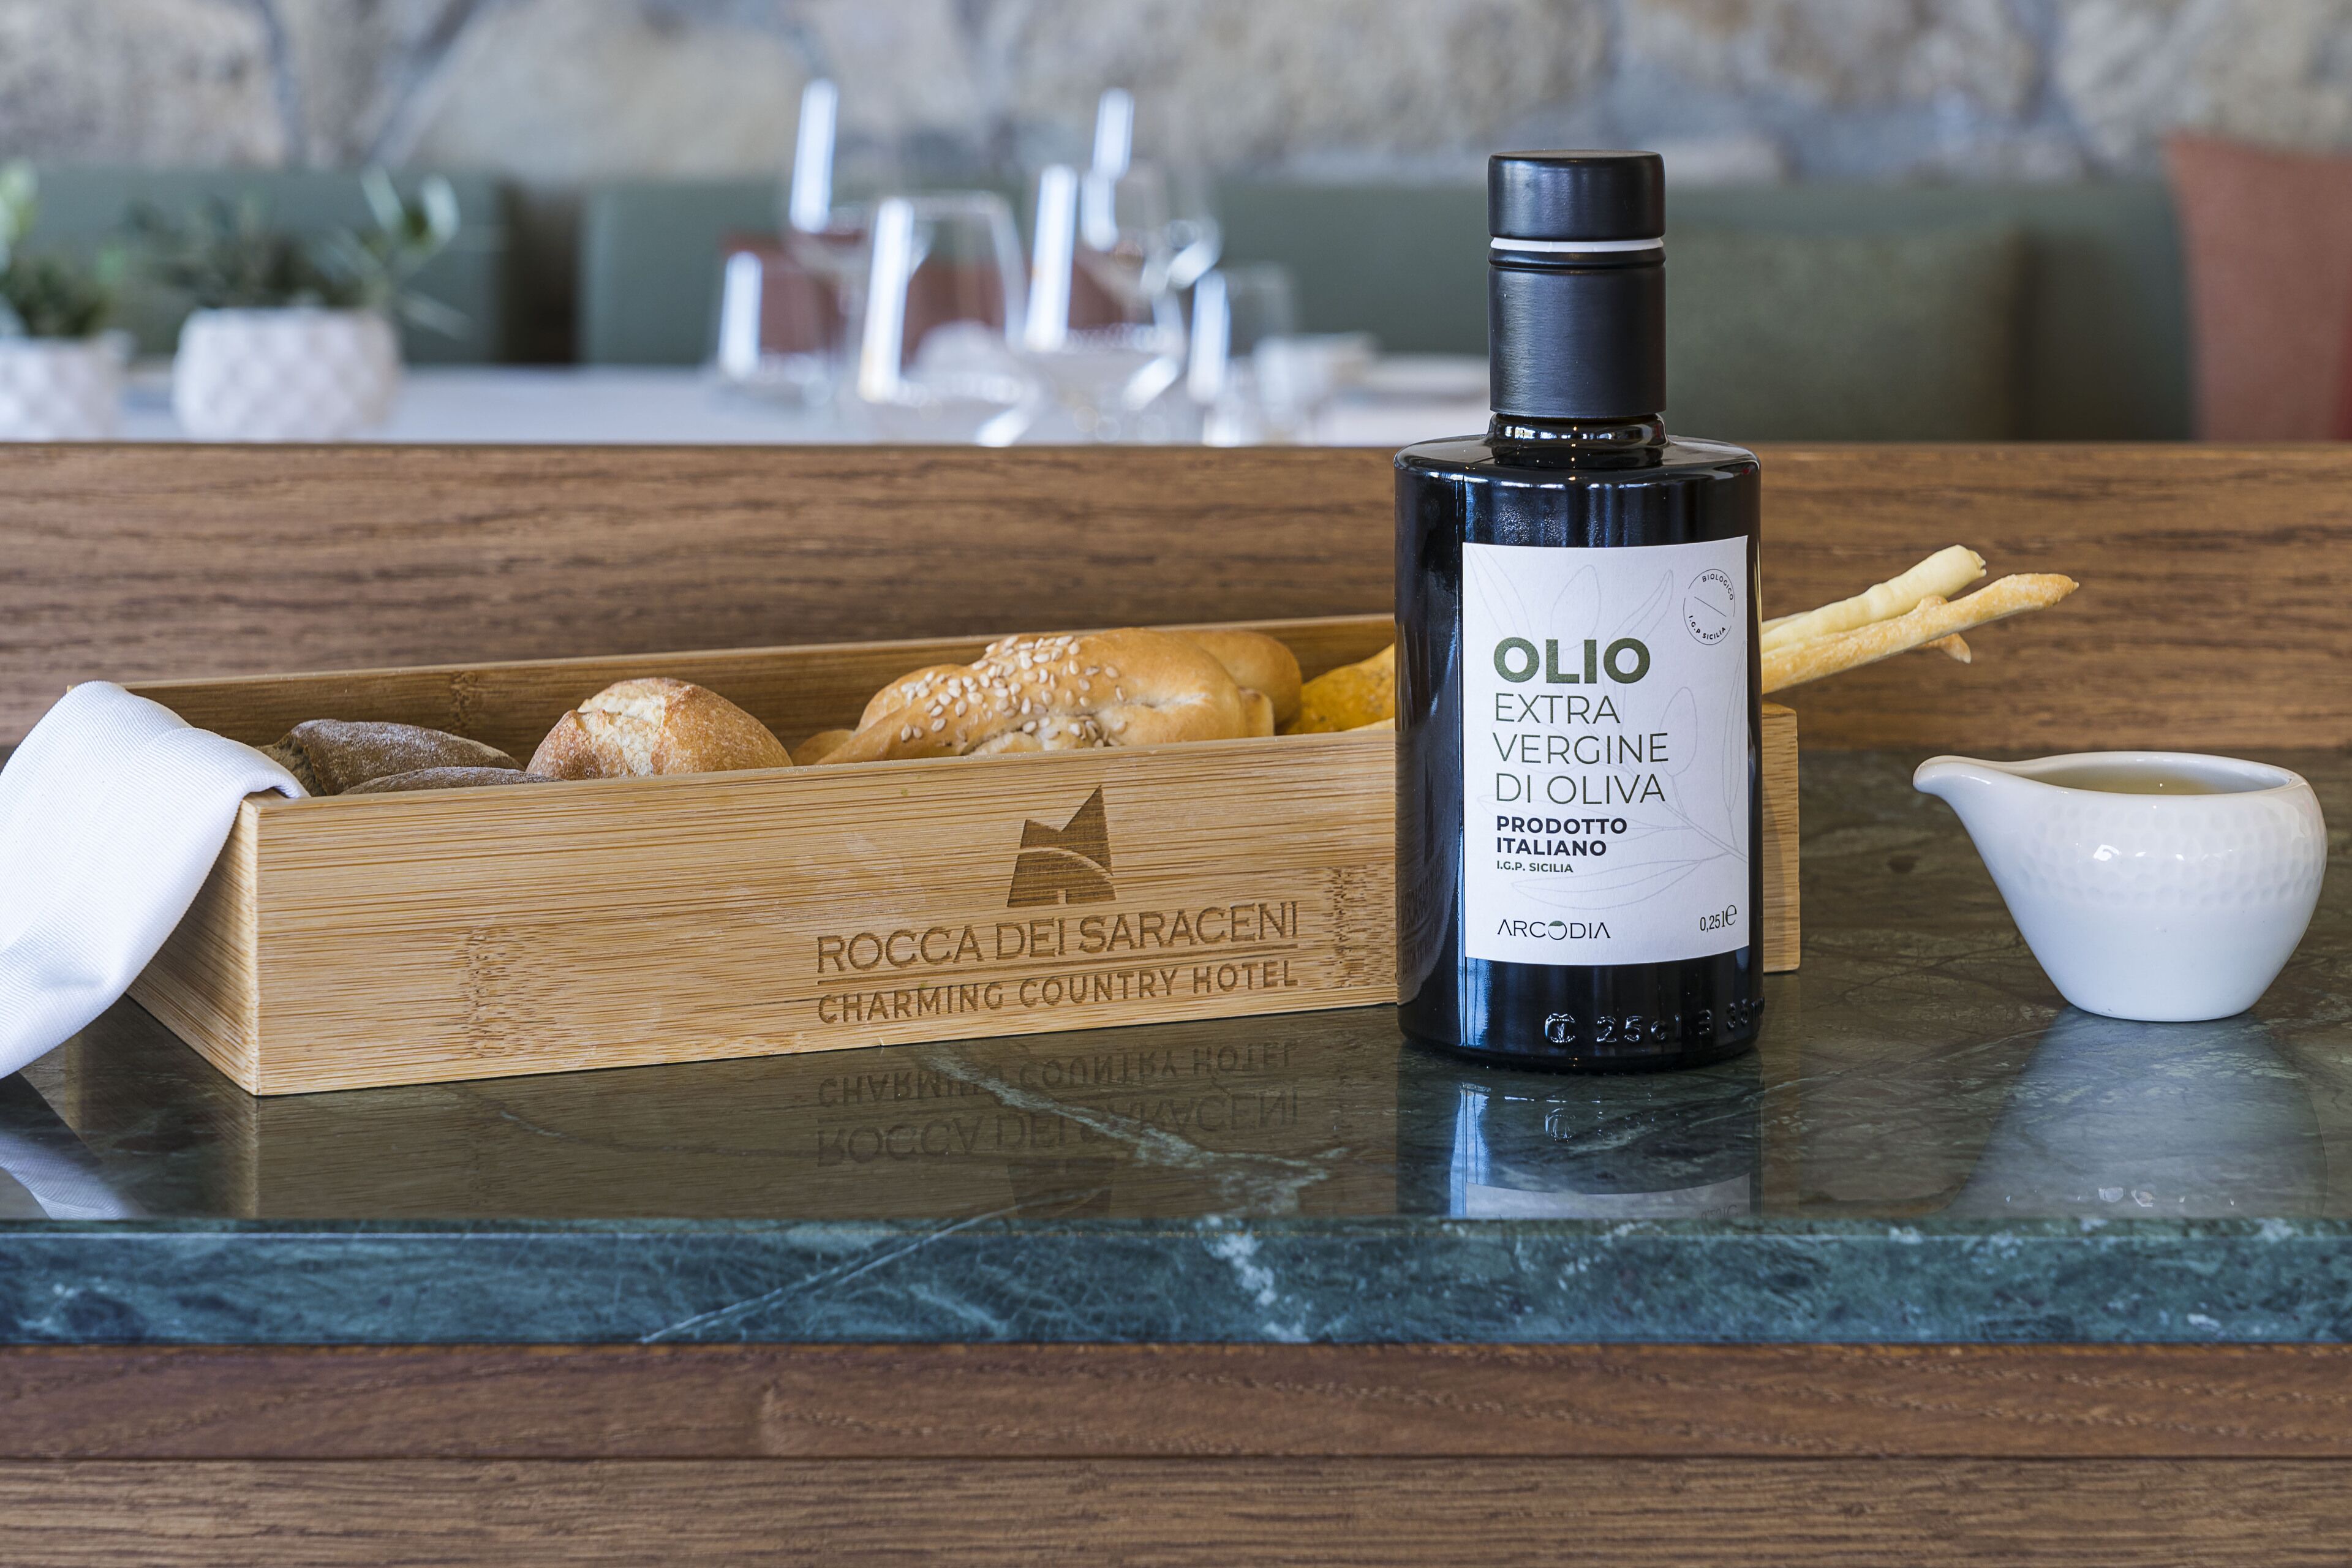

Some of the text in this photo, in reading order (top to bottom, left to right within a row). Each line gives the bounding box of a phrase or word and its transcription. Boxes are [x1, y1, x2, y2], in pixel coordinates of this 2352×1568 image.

[1702, 573, 1734, 601] BIOLOGICO
[1702, 626, 1726, 640] SICILIA
[1493, 636, 1651, 684] OLIO
[1495, 692, 1621, 725] EXTRA
[1492, 732, 1669, 765] VERGINE
[1496, 772, 1666, 805] DI OLIVA
[1496, 815, 1628, 835] PRODOTTO
[1496, 837, 1607, 857] ITALIANO
[1496, 860, 1574, 873] I.G.P. SICILIA
[816, 900, 1300, 974] ROCCA DEI SARACENI
[1496, 919, 1611, 941] ARCODIA
[817, 960, 1300, 1025] CHARMING COUNTRY HOTEL
